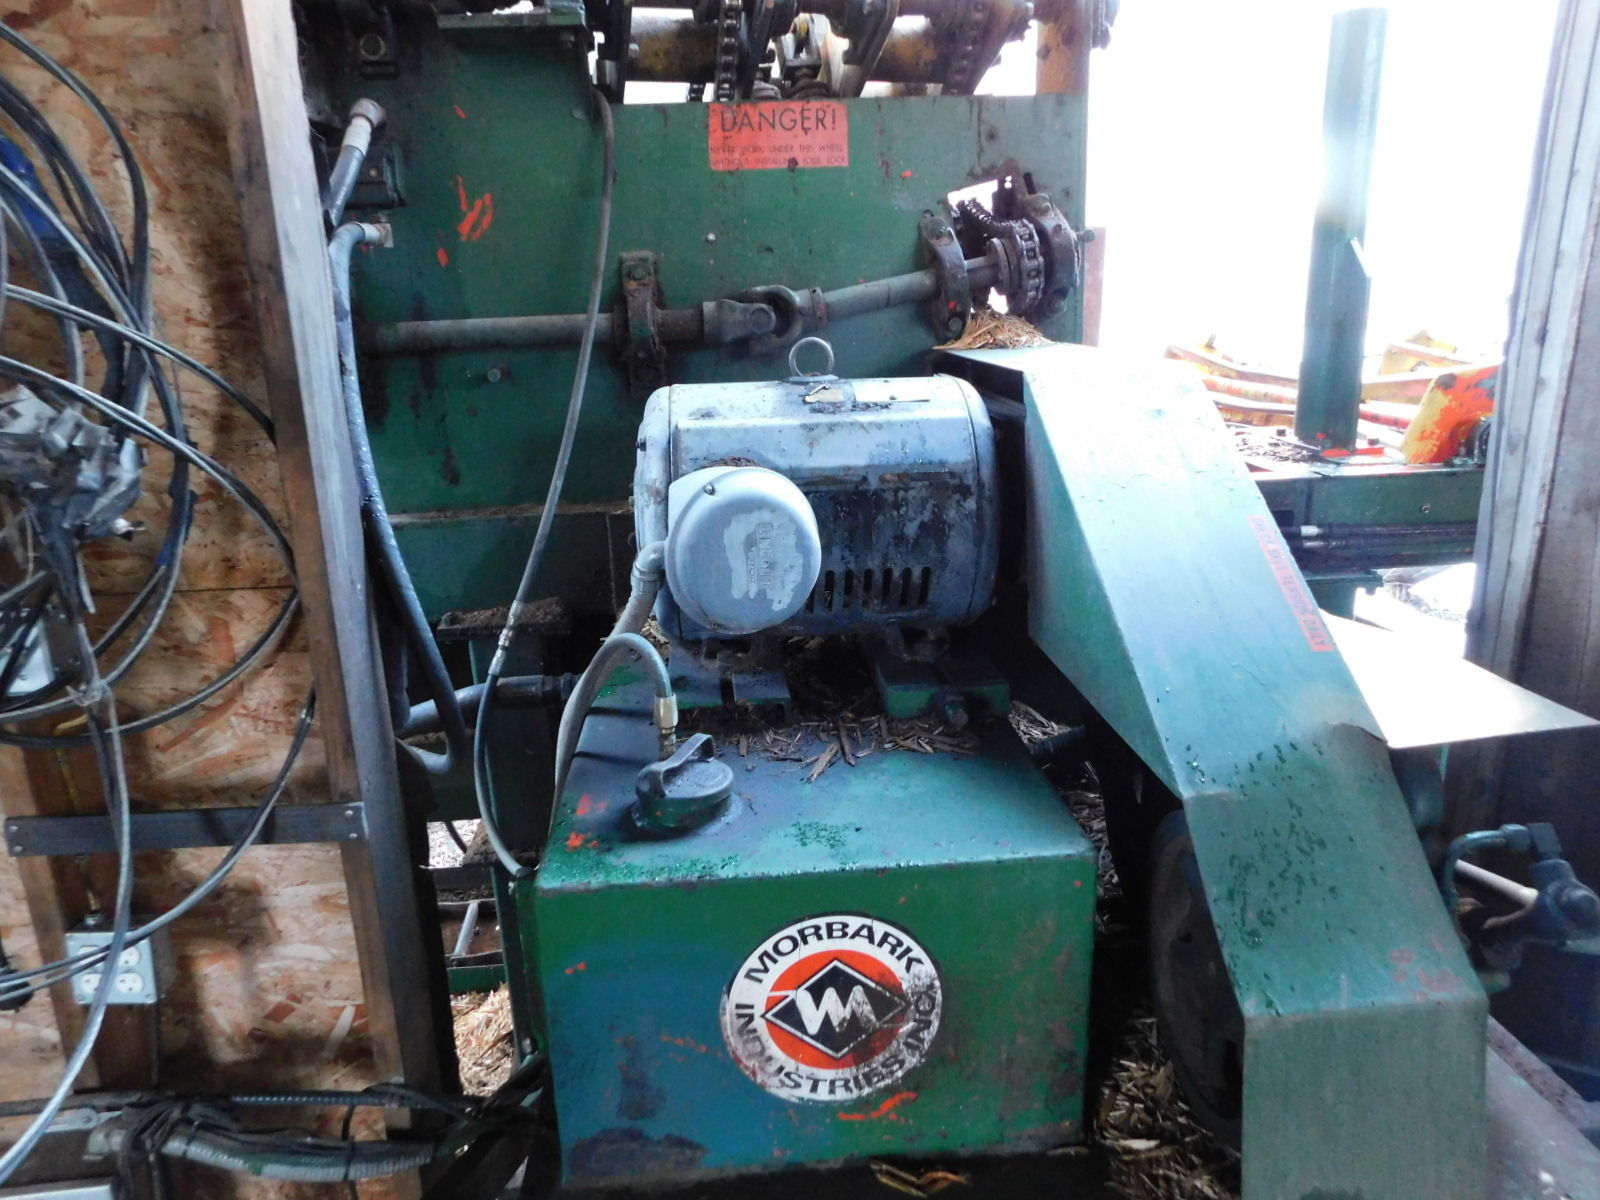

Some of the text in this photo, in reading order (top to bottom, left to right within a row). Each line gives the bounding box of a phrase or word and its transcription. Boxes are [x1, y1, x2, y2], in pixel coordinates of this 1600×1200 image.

[721, 107, 836, 132] DANGER!
[770, 144, 794, 152] UNDER
[820, 144, 842, 152] WHEEL
[744, 922, 924, 984] MORBARK
[735, 1002, 906, 1095] INDUSTRIES
